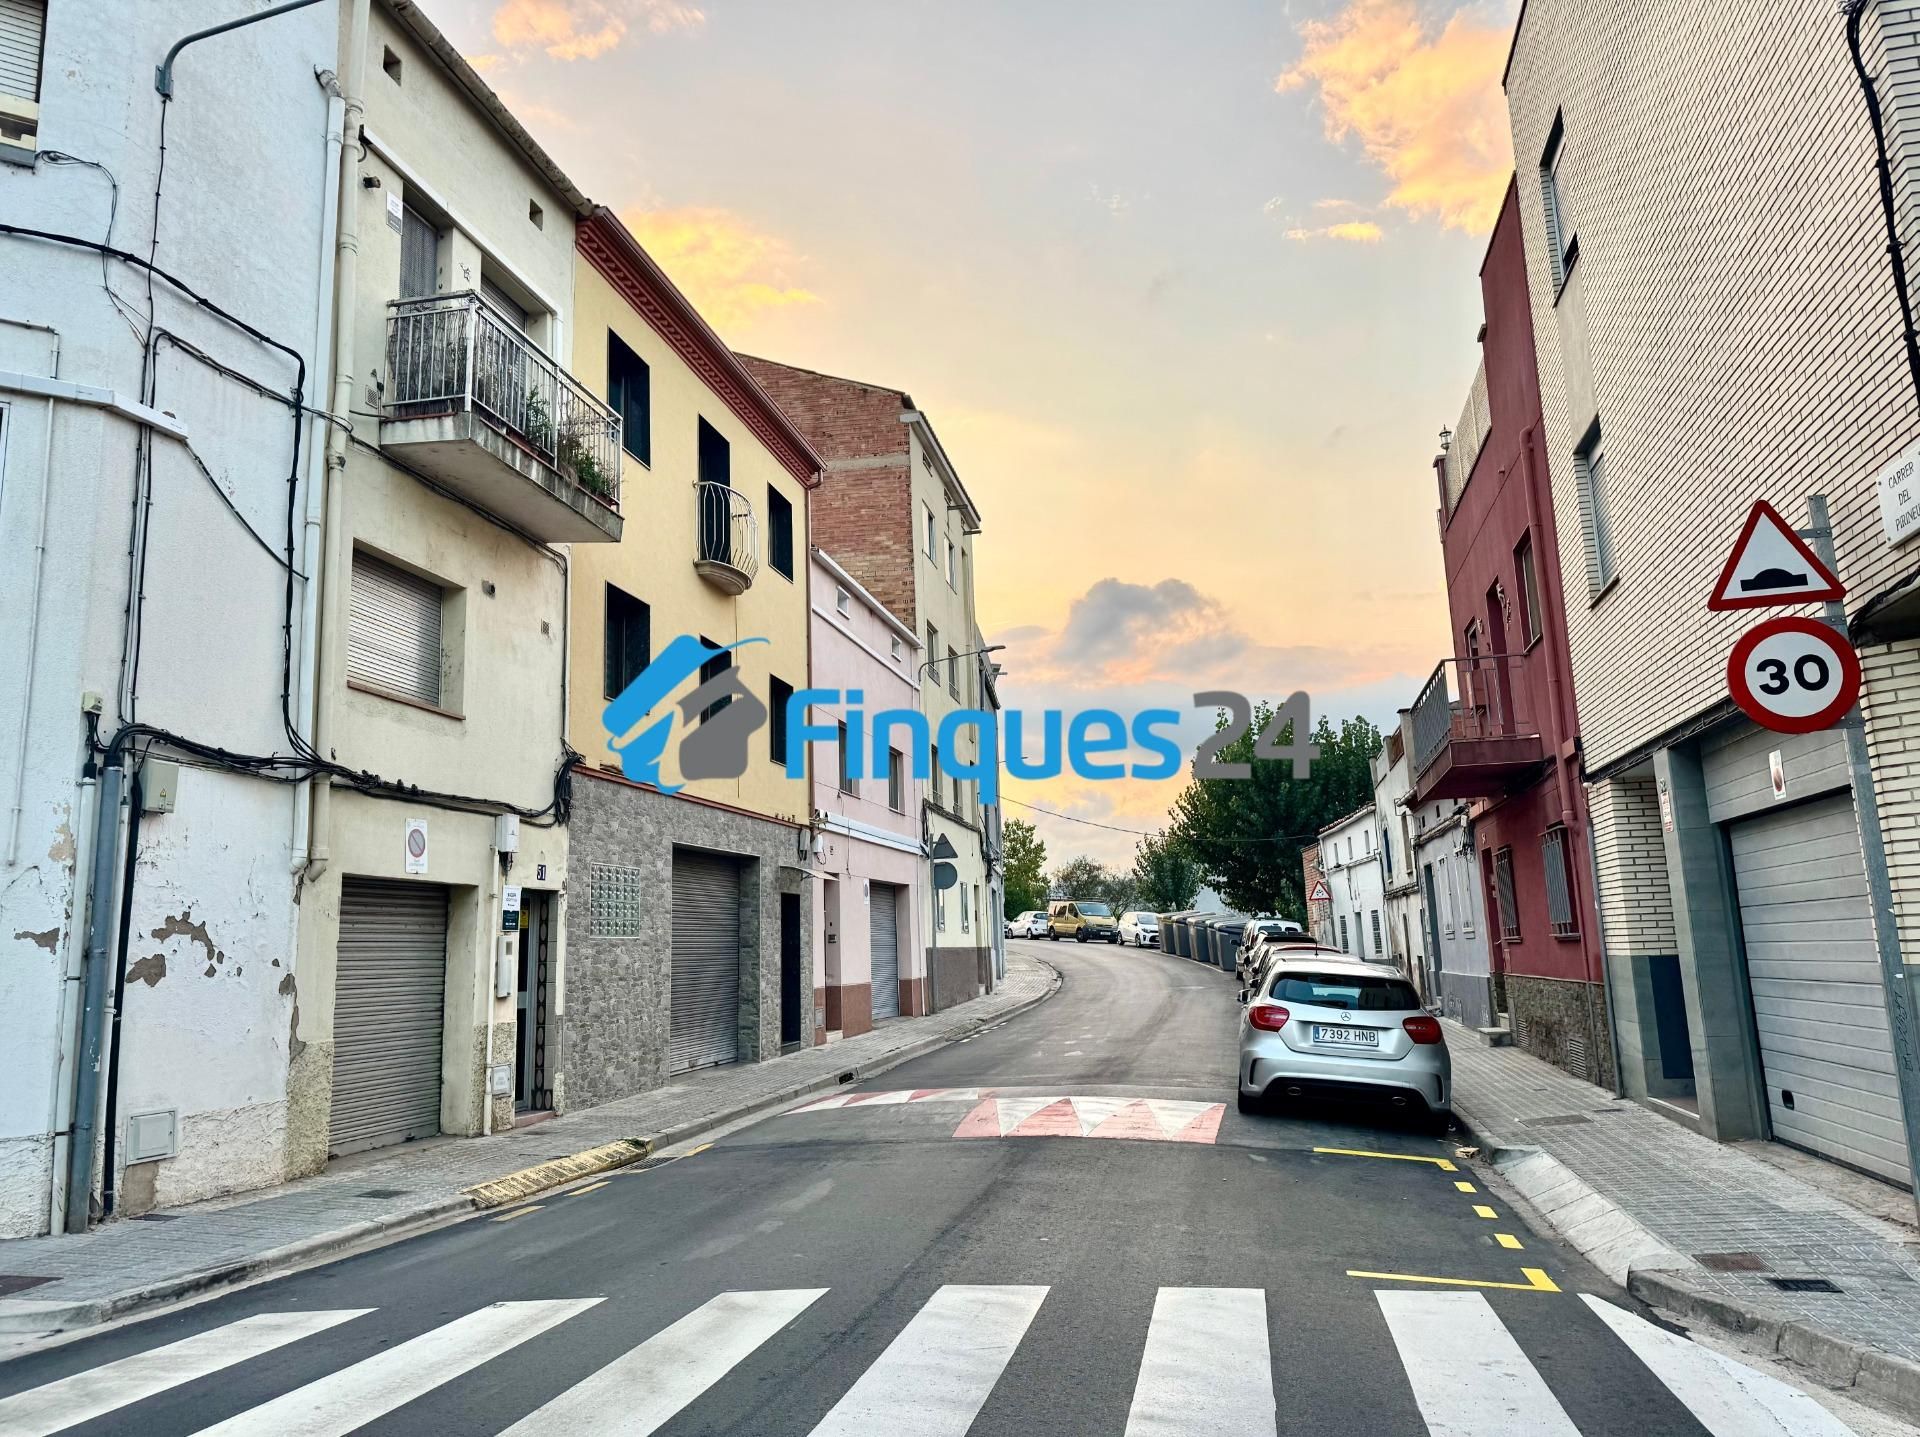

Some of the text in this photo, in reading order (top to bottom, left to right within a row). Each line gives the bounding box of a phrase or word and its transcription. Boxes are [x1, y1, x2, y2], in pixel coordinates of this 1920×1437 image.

[1888, 461, 1914, 489] CARRER
[1898, 488, 1911, 506] DEL
[1756, 653, 1830, 696] 30
[1321, 1028, 1376, 1042] 7392 HNB
